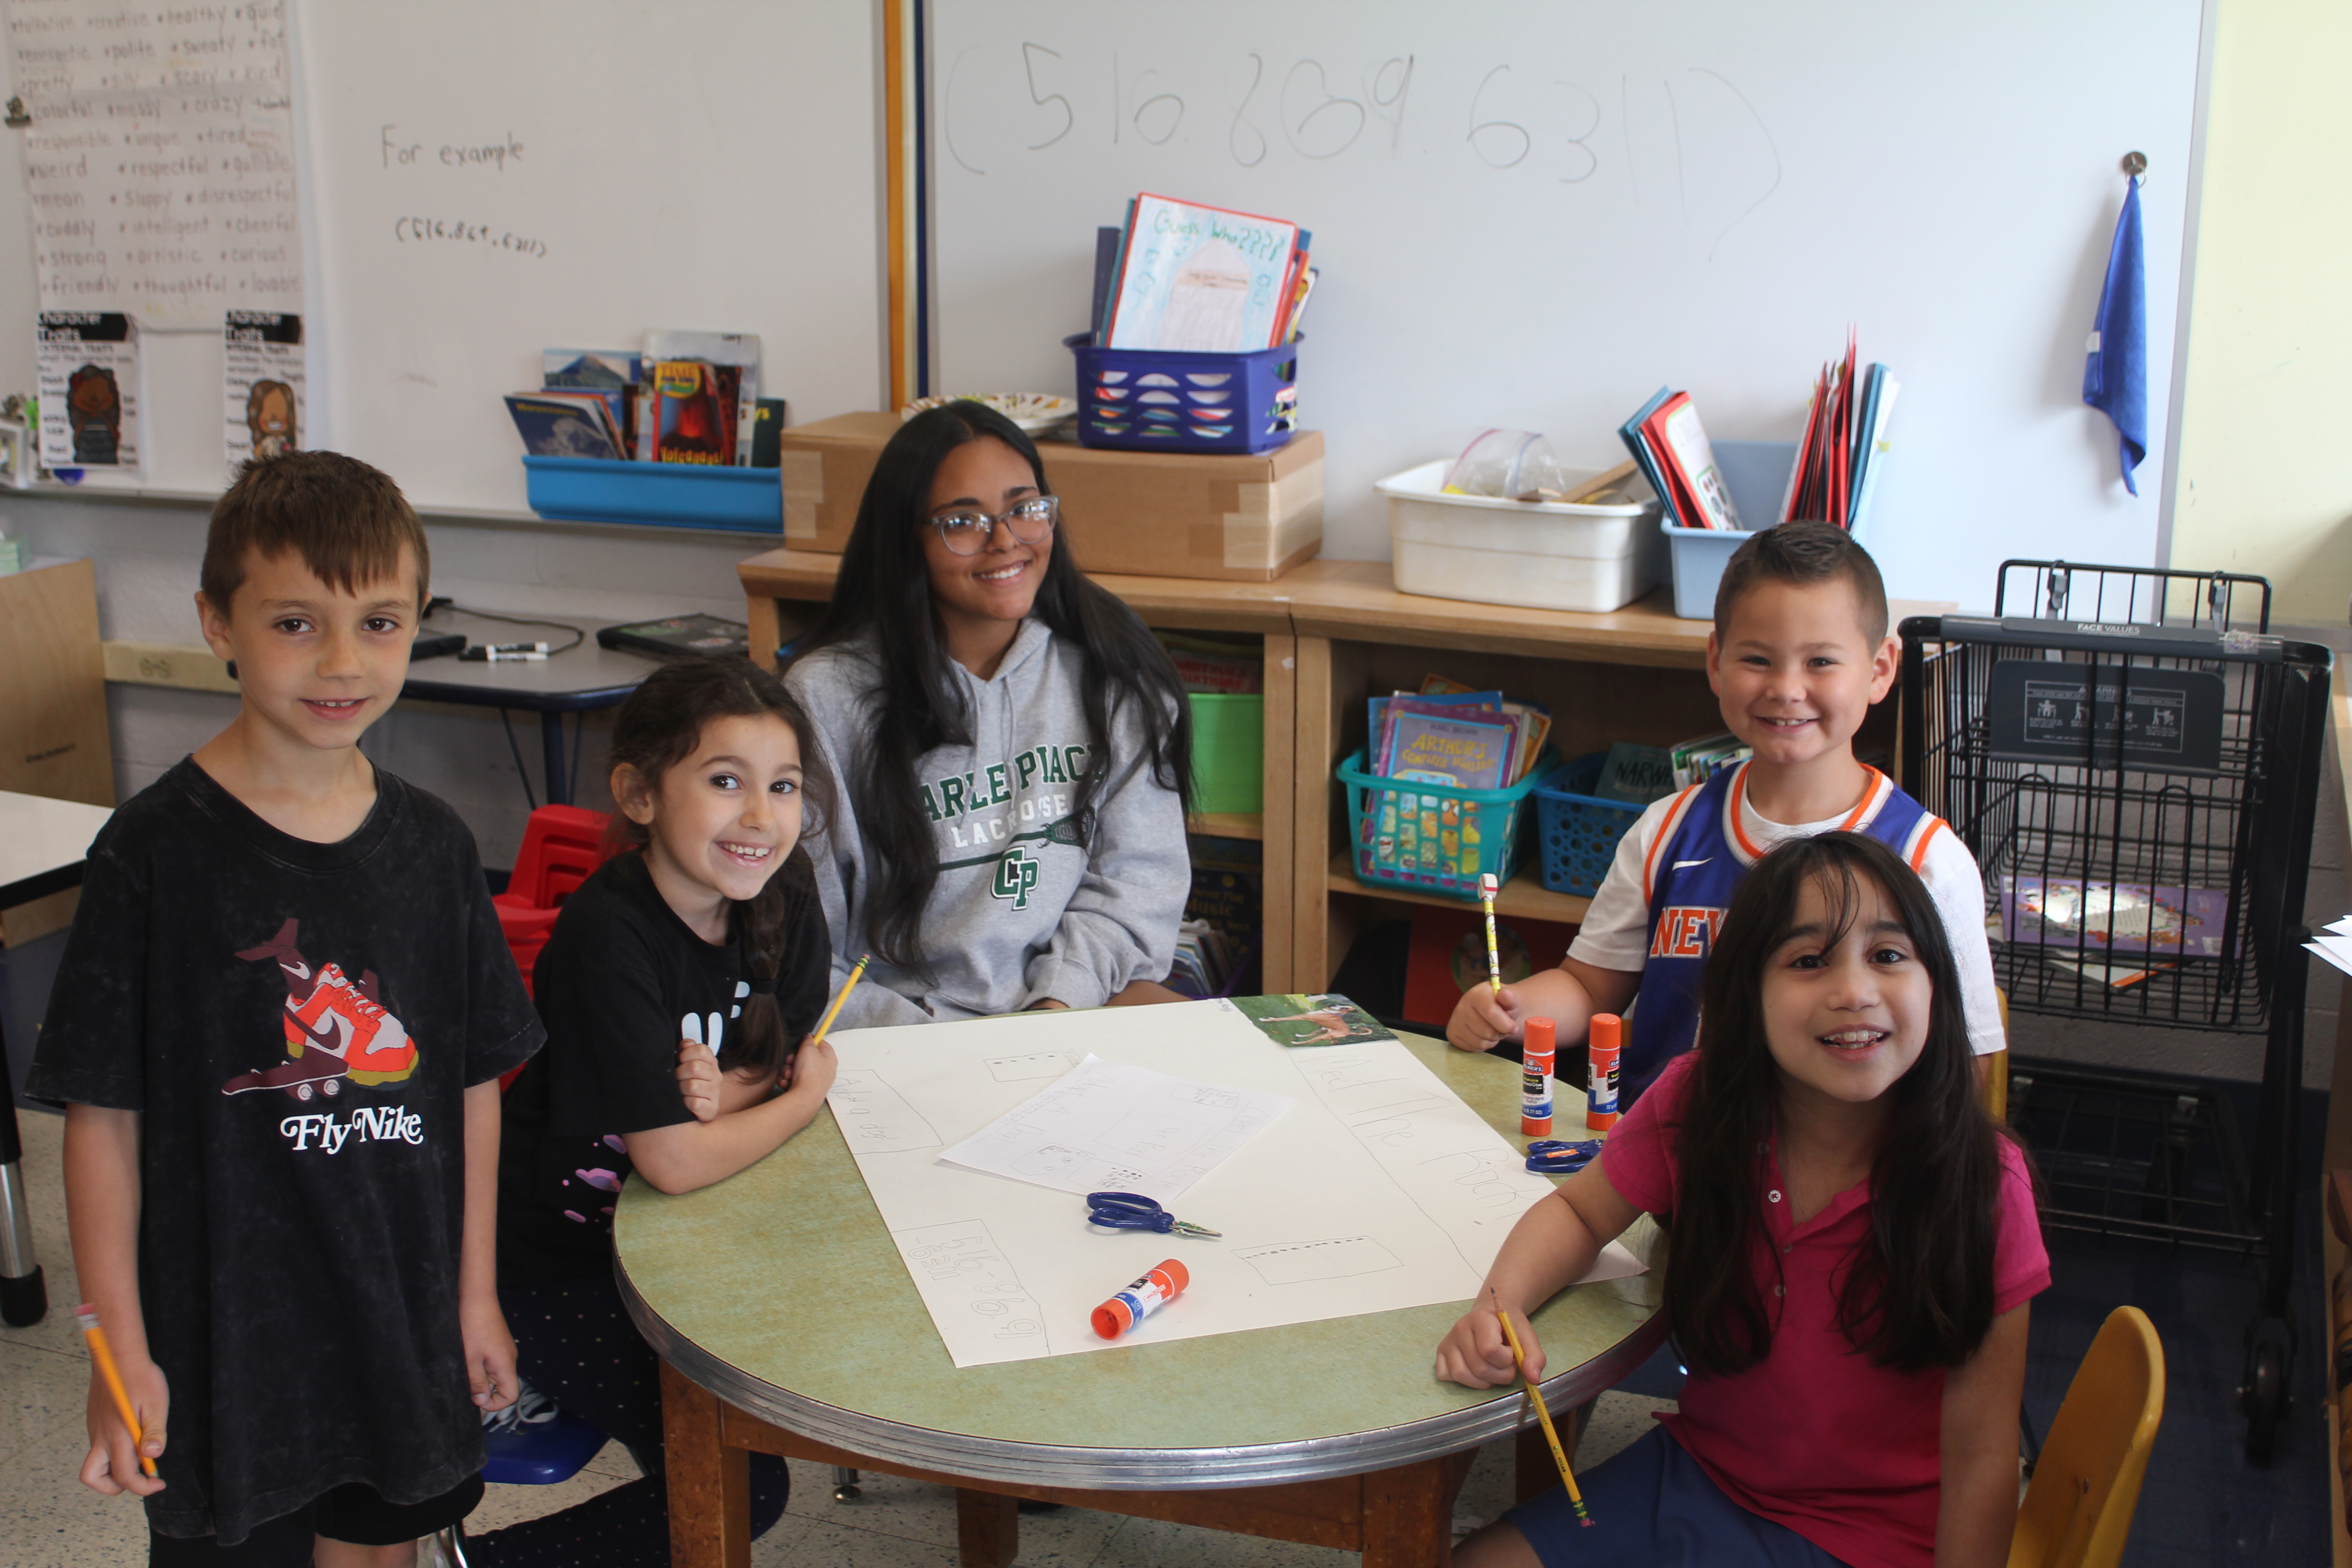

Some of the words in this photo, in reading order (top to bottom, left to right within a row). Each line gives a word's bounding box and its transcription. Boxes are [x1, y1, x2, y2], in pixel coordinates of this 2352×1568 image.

[167, 5, 227, 39] healthy
[113, 40, 156, 65] polite
[28, 76, 74, 94] pretty
[34, 100, 91, 120] colorful
[116, 100, 162, 120] messy
[194, 95, 244, 119] crazy
[34, 133, 111, 153] responsible
[206, 127, 246, 144] tired
[382, 123, 422, 169] For
[439, 131, 524, 172] example
[35, 153, 88, 178] weird
[131, 157, 209, 182] respectful
[199, 179, 297, 206] disrespectful
[46, 219, 96, 246] cuddly
[132, 217, 209, 242] intelligent
[1154, 207, 1200, 235] Guess
[1212, 221, 1286, 262] Who????
[49, 249, 107, 272] strong
[137, 248, 203, 265] artistic
[230, 246, 287, 264] curious
[51, 275, 119, 299] friendly
[143, 274, 227, 300] thoughtful
[38, 328, 81, 342] Traits
[226, 328, 264, 341] Traits
[2078, 623, 2103, 632] FACE
[2104, 625, 2140, 635] VALUES
[1402, 749, 1448, 769] COMPUTER
[1411, 733, 1488, 760] ARTHUR'S
[919, 761, 1011, 822] ARLE
[1014, 744, 1096, 790] PLAC
[951, 794, 1069, 848] LACROSE
[1298, 1055, 1409, 1091] Meet
[279, 1113, 352, 1155] Fly
[352, 1105, 424, 1145] Nike
[1348, 1090, 1455, 1147] The
